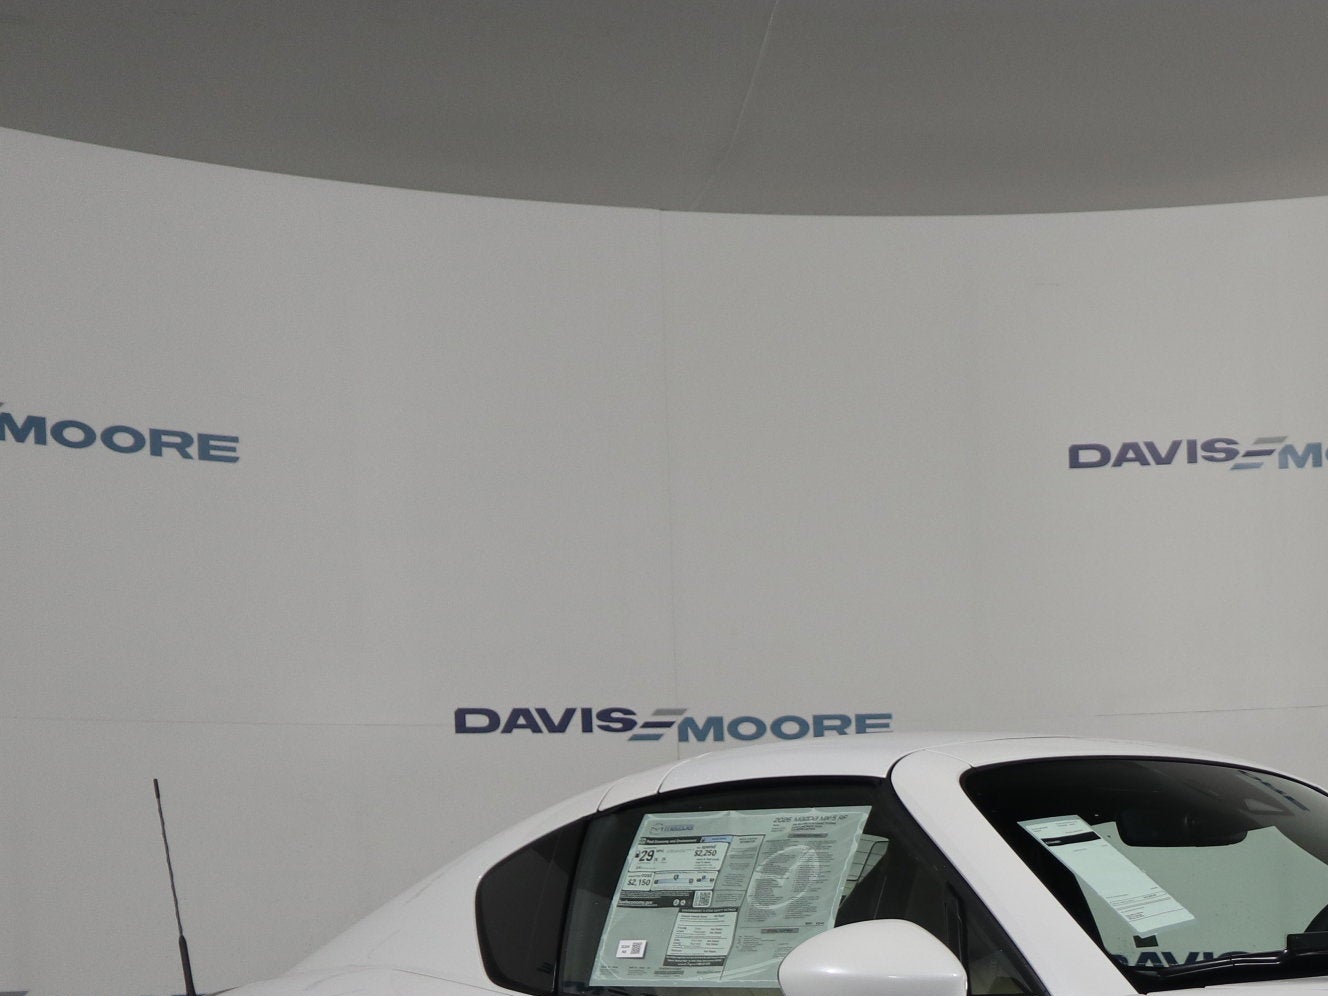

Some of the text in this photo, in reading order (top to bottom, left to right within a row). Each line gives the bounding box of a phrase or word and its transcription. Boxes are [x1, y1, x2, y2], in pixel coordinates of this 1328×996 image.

[0, 412, 240, 463] MOORE
[1068, 437, 1240, 469] DAVIS
[454, 707, 893, 742] DAVIS MOORE
[639, 850, 655, 862] 29
[627, 878, 651, 886] $2,150
